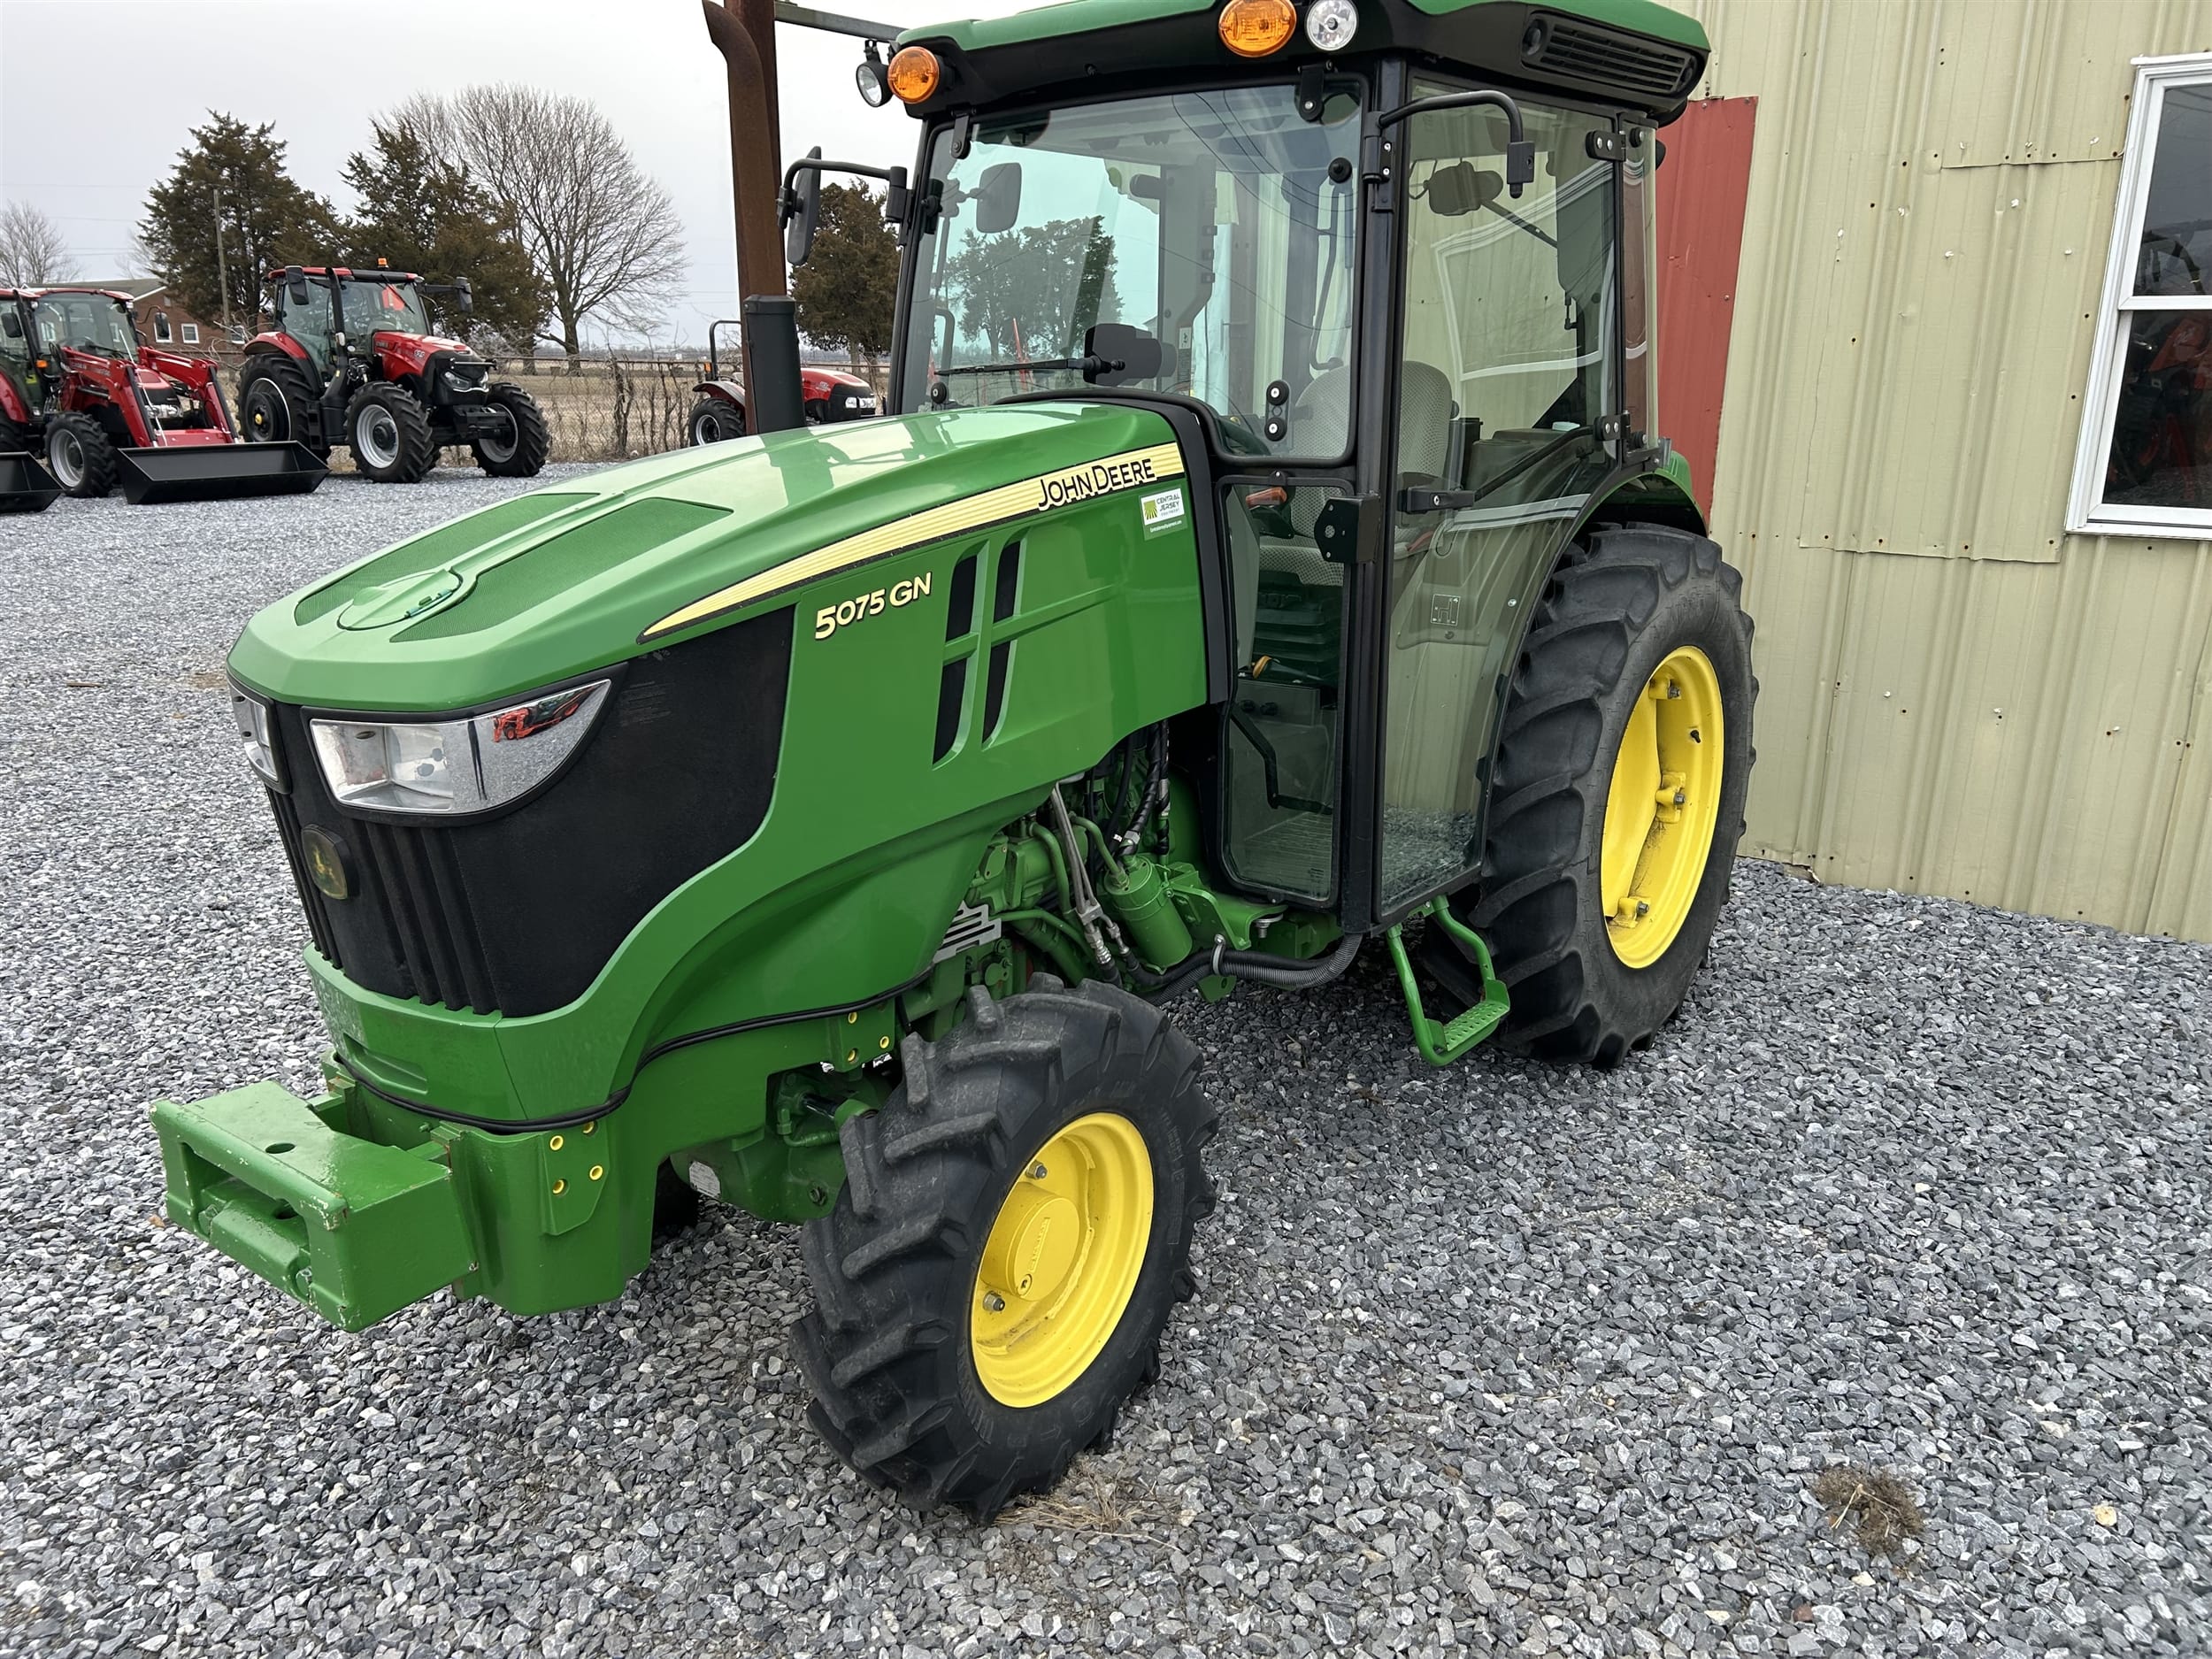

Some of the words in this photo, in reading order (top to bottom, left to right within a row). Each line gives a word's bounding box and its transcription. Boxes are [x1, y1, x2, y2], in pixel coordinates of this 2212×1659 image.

[1038, 472, 1094, 509] JOHN
[1091, 457, 1156, 492] DEERE
[1156, 493, 1180, 505] CENTRAL
[1159, 501, 1180, 512] JERSEY
[814, 588, 886, 640] 5075
[889, 571, 932, 608] GN
